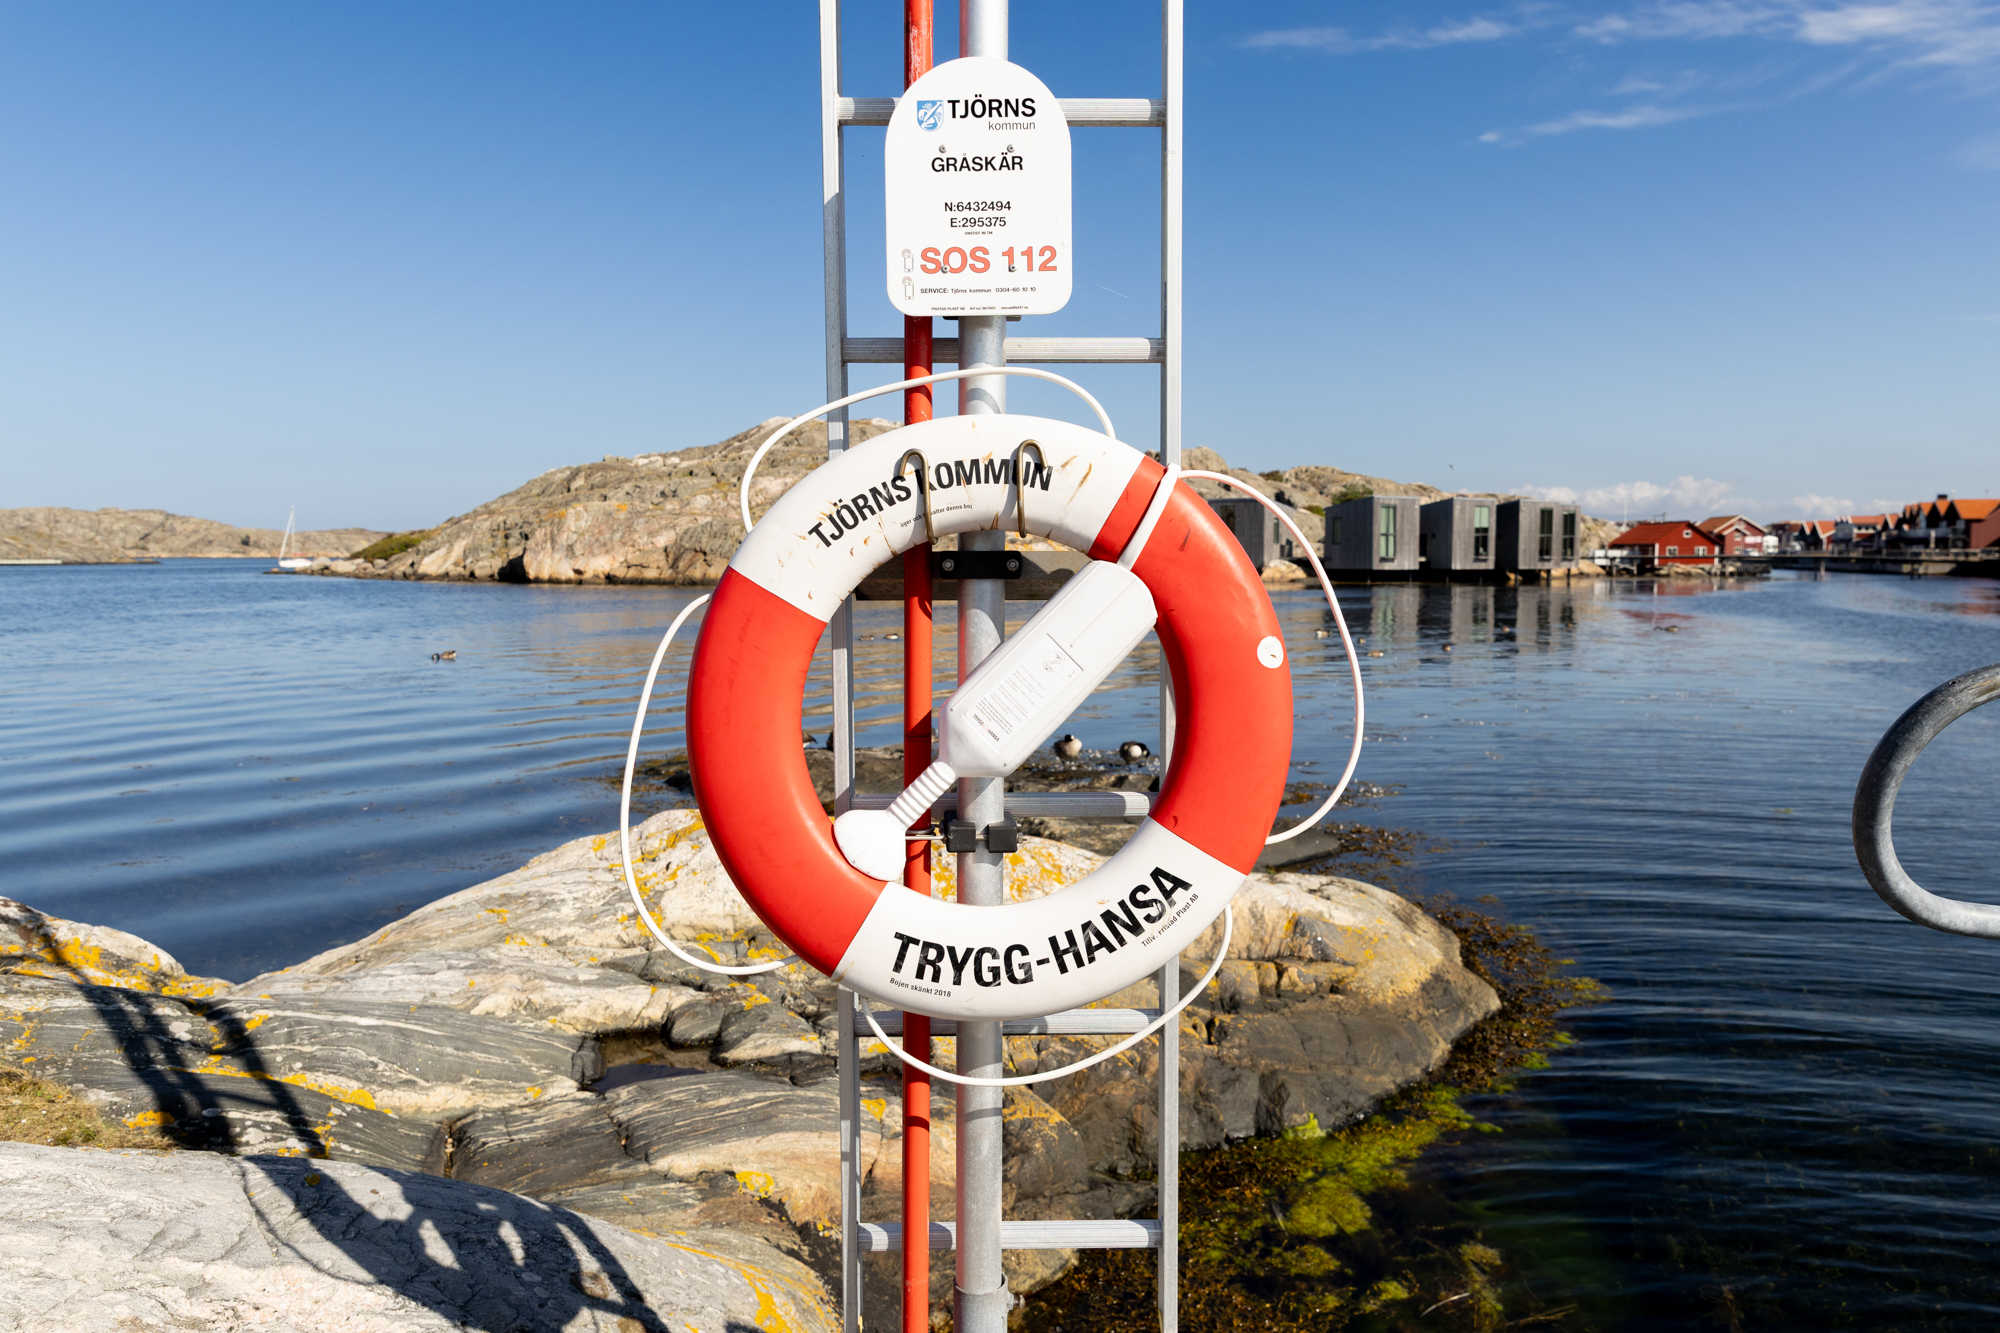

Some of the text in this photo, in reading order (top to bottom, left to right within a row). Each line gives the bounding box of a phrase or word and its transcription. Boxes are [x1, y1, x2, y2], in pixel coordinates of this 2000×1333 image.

[947, 94, 1036, 119] TJÖRNS
[988, 121, 1036, 131] kommun
[931, 153, 1023, 172] GRÅSKÄR
[944, 200, 1012, 212] N:6432494
[950, 216, 1007, 228] E:295375
[920, 245, 1058, 274] SOS 112
[807, 458, 1053, 548] TJÖRNS KOMMUN
[900, 518, 912, 528] äger
[912, 514, 923, 522] och
[946, 504, 962, 512] denna
[1175, 901, 1192, 917] Plast
[1189, 893, 1199, 904] AB
[892, 866, 1193, 988] TRYGG-HANSA
[889, 977, 952, 998] Bojen skänkt 2018
